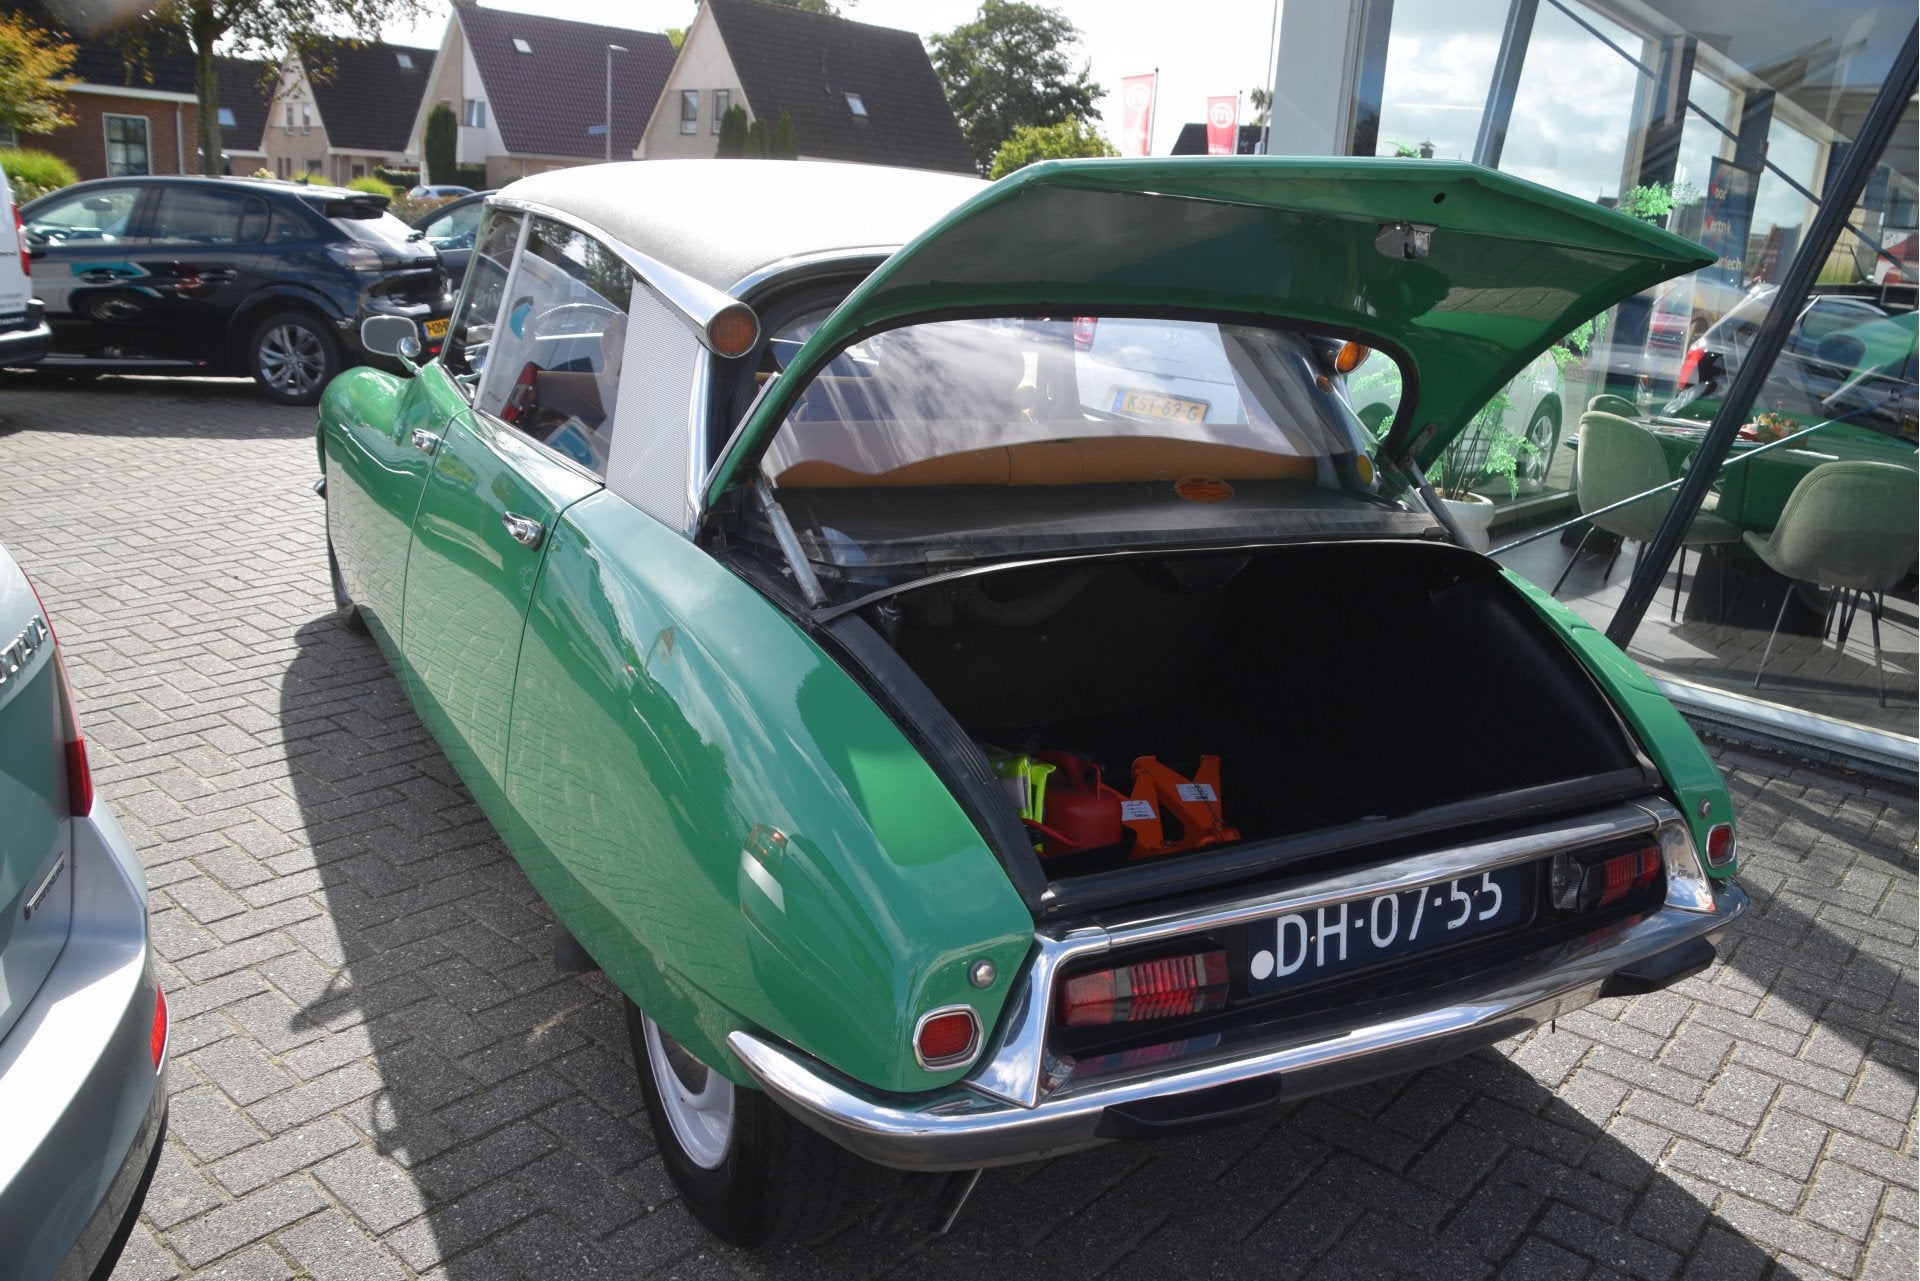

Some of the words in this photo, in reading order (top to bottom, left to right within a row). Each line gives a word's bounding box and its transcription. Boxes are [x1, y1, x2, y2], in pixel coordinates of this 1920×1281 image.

[1711, 182, 1727, 200] Voor
[1126, 394, 1199, 421] KST-62-G
[1276, 872, 1502, 978] DH-07-55
